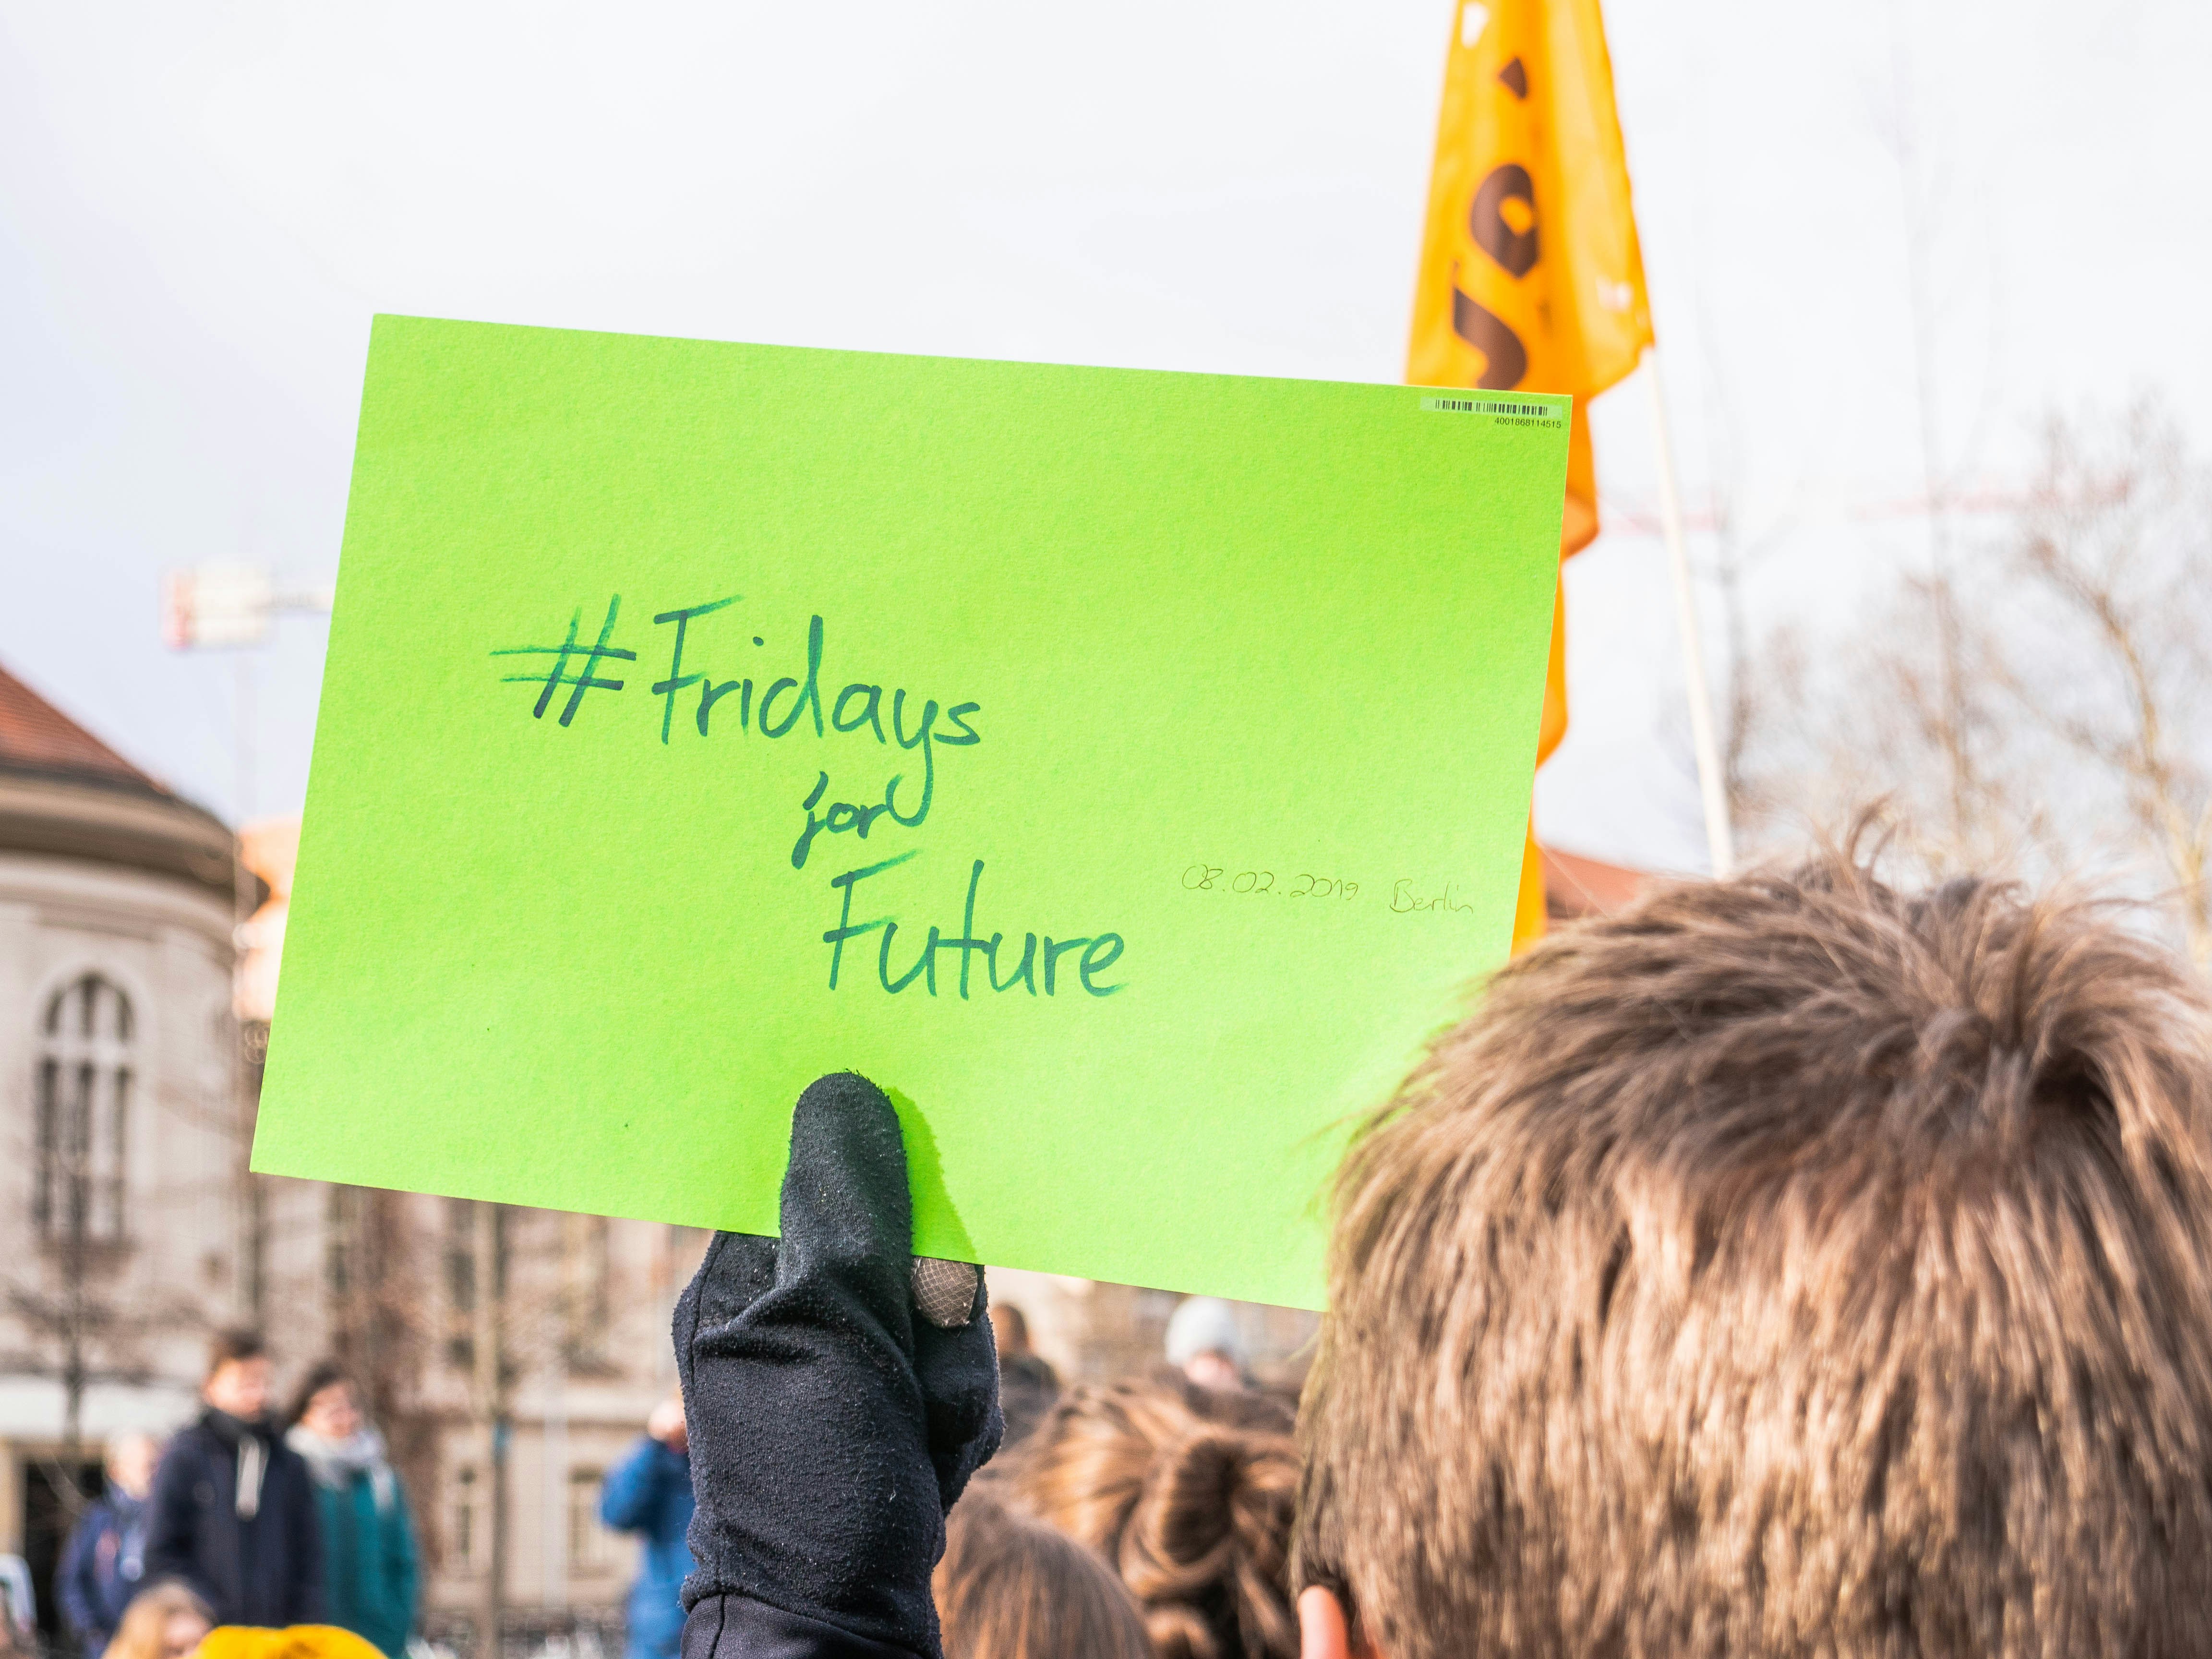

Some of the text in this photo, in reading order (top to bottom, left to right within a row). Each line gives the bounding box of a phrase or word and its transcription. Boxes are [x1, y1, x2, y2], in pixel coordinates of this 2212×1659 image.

[1494, 417, 1562, 429] 4001868114515
[490, 592, 981, 827] #Fridays
[823, 848, 1128, 1000] Future
[1181, 864, 1474, 914] 08.02.2019 Berlin
